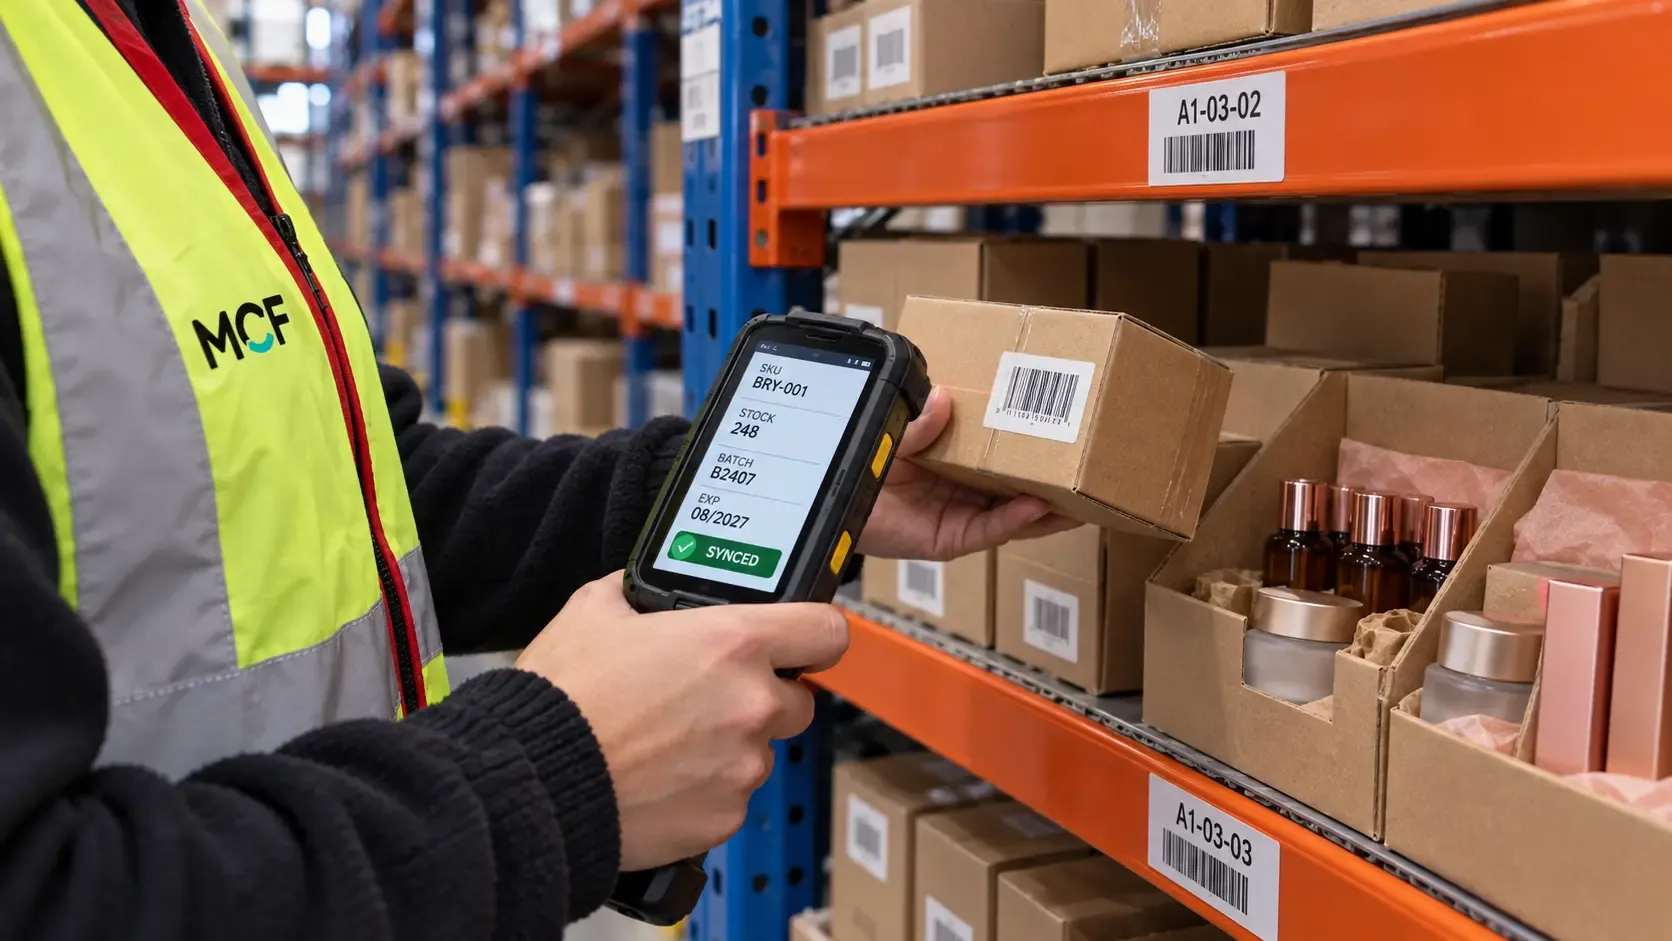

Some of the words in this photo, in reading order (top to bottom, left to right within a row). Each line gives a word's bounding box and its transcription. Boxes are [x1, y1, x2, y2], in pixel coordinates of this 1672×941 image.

[1177, 89, 1262, 126] A1-03-02
[192, 294, 289, 369] MCF
[760, 363, 782, 375] SKU
[752, 376, 808, 397] BRY-001
[739, 408, 776, 424] STOCK
[730, 421, 760, 439] 248
[717, 453, 754, 468] BATCH
[710, 466, 756, 486] B2407
[698, 493, 720, 506] EXP
[691, 507, 750, 529] 08/2027
[706, 546, 760, 567] SYNCED
[1176, 801, 1253, 867] A1-03-03
